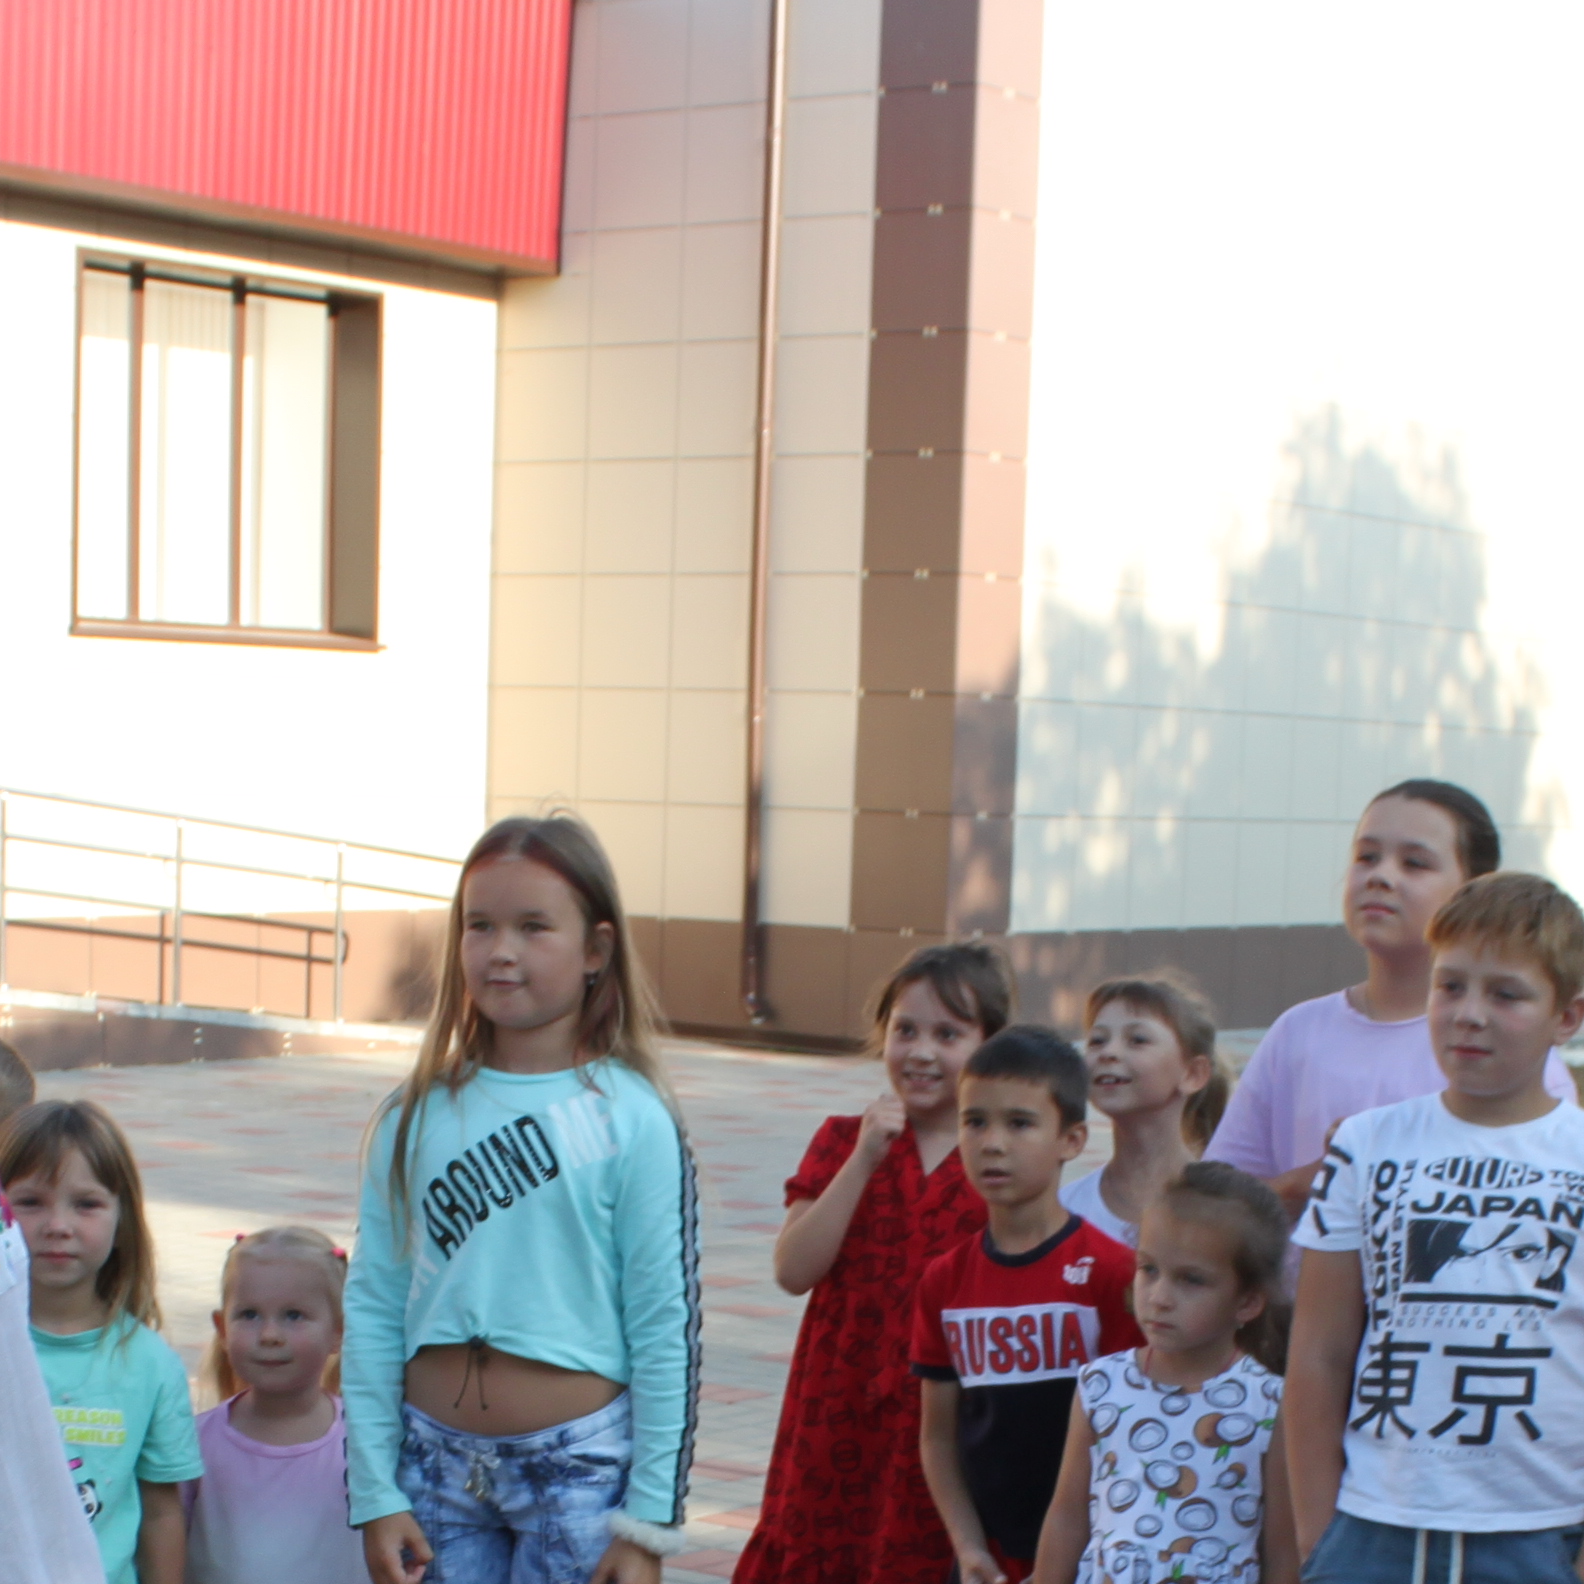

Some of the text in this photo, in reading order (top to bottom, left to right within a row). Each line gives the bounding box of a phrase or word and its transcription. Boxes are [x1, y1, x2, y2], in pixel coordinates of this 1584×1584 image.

[422, 1115, 559, 1262] AROUND
[1371, 1160, 1399, 1332] TOKYO
[945, 1311, 1090, 1377] RUSSIA
[1395, 1317, 1488, 1330] NOTHING
[1400, 1304, 1497, 1318] SUCCESS
[1348, 1331, 1553, 1445] 東京
